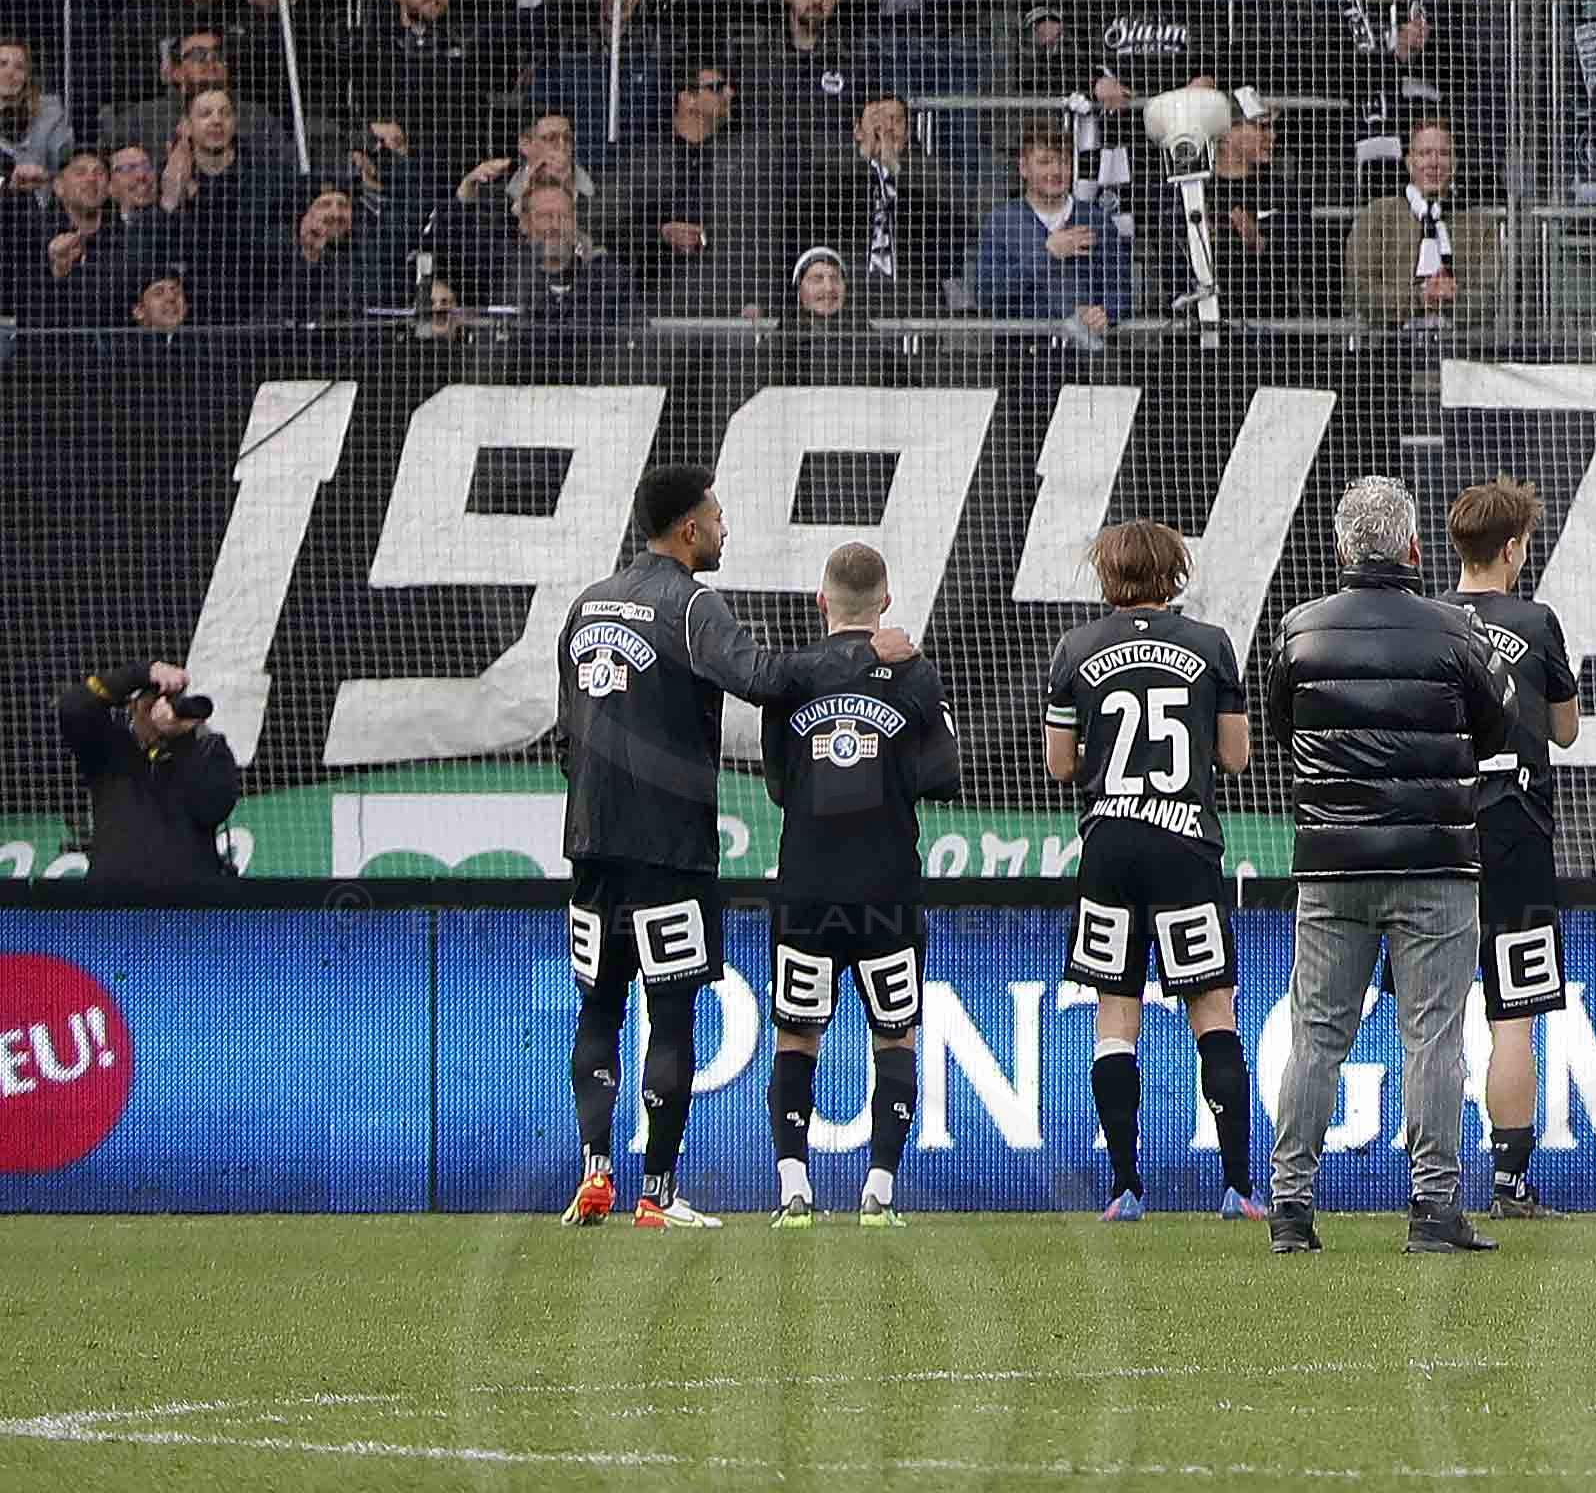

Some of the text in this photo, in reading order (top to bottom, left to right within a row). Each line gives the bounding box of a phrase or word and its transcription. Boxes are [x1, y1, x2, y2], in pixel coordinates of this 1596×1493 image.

[568, 624, 650, 670] PUNTIGAMER
[1088, 644, 1199, 680] PUNTIGAMER
[794, 696, 898, 735] PUNTIGAMER
[1101, 686, 1190, 796] 25
